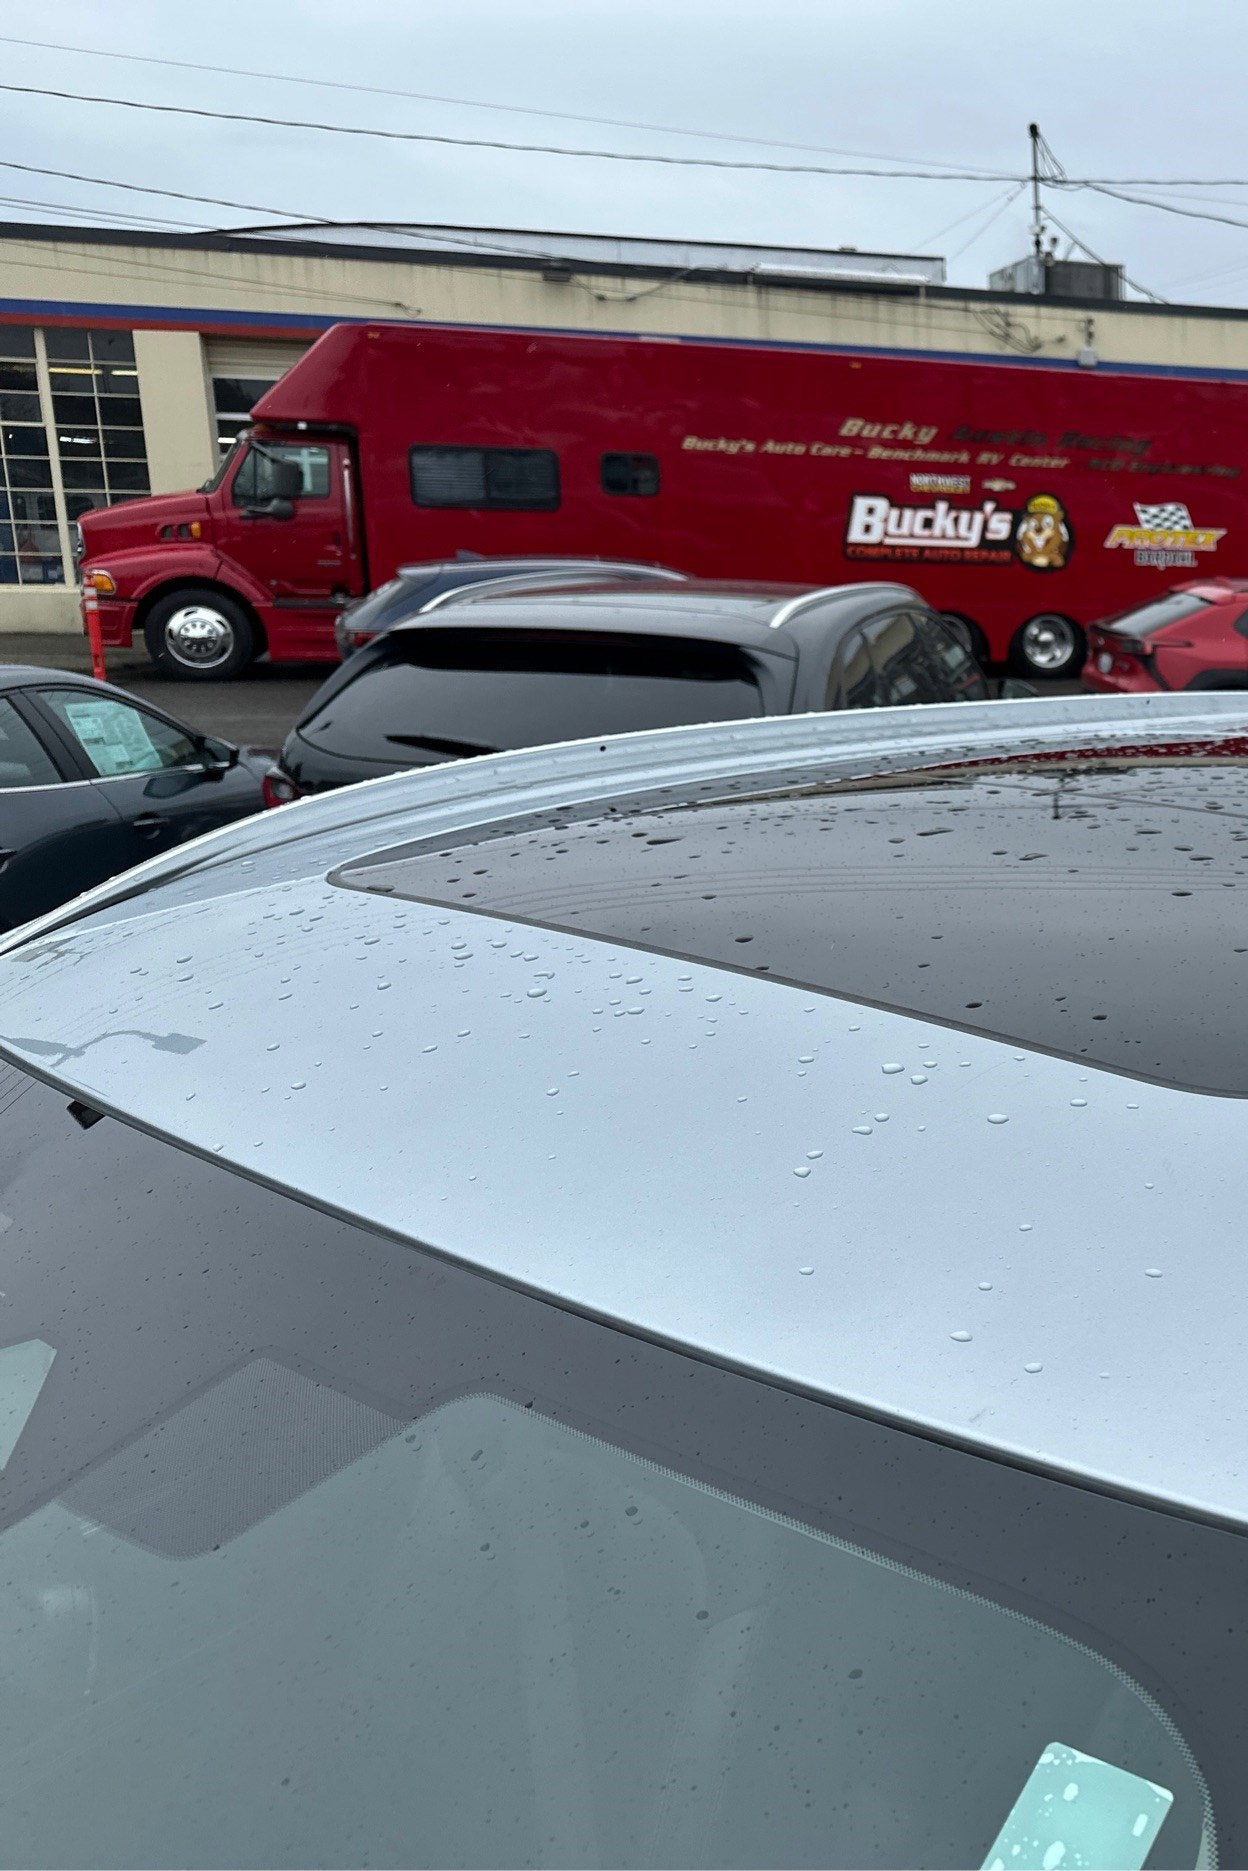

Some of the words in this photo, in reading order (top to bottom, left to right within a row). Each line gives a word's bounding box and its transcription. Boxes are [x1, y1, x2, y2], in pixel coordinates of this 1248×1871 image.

[839, 416, 938, 445] Bucky
[681, 435, 756, 454] Bucky's
[759, 439, 807, 455] Auto
[866, 445, 970, 464] Benchmark
[1009, 452, 1070, 468] Center
[848, 495, 1013, 547] Bucky's
[923, 547, 961, 560] AUTO
